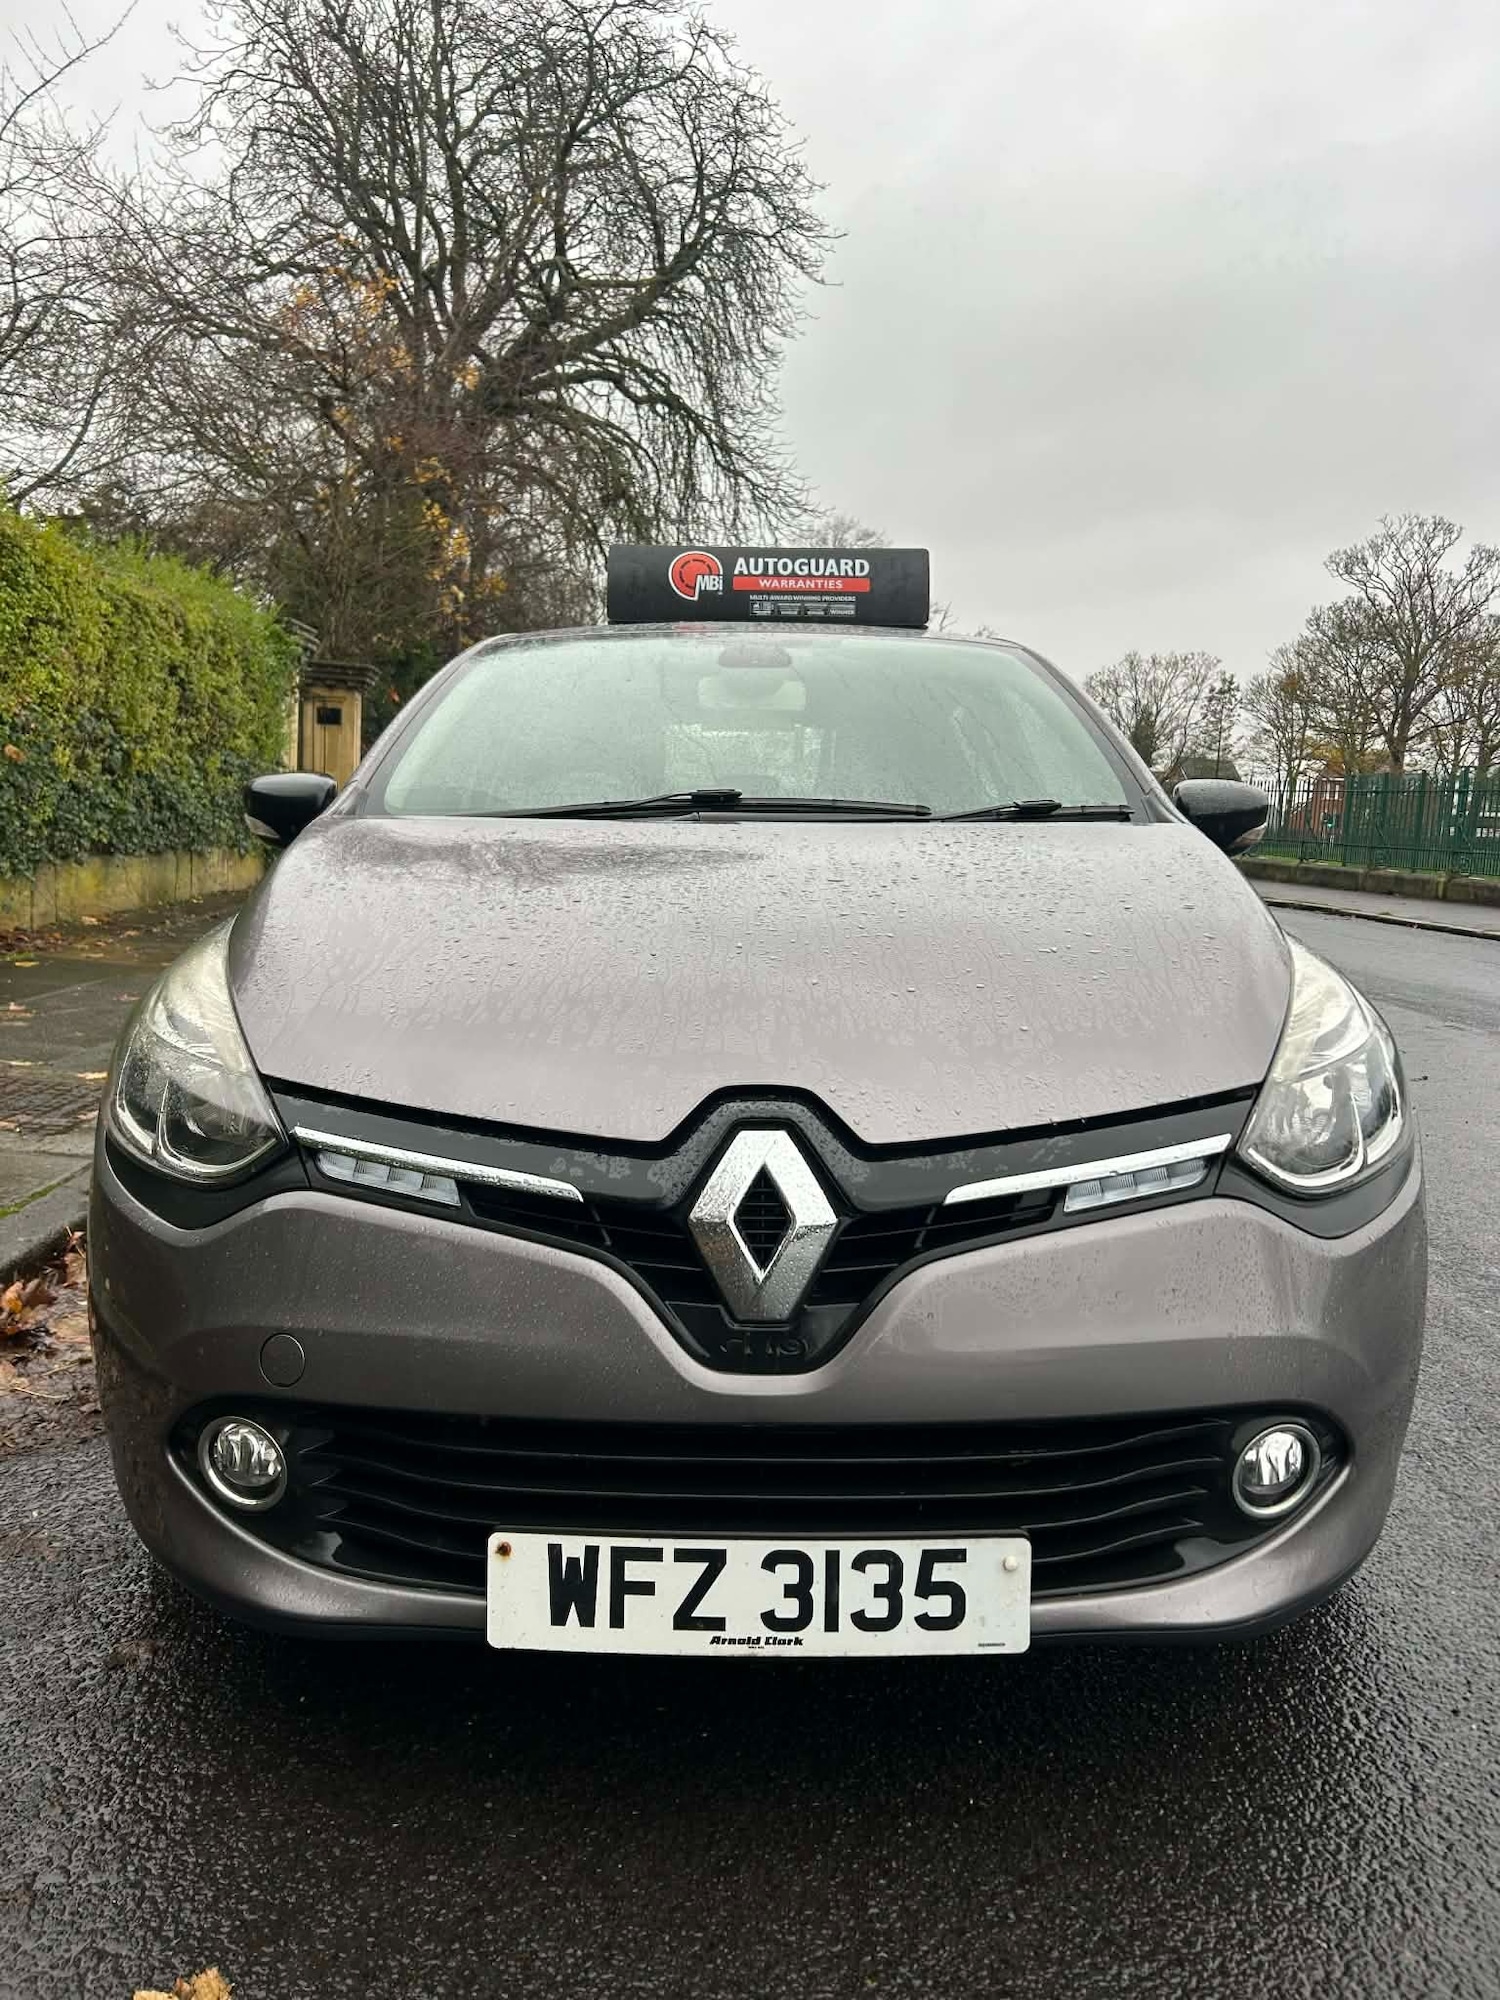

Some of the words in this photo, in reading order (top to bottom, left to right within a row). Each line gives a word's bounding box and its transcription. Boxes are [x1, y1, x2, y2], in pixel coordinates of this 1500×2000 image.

[734, 557, 870, 576] AUTOGUARD
[759, 579, 843, 590] WARRANTIES
[547, 1543, 727, 1631] WFZ
[760, 1549, 967, 1633] 3135
[709, 1636, 761, 1646] Arnold
[764, 1636, 804, 1646] Clark
